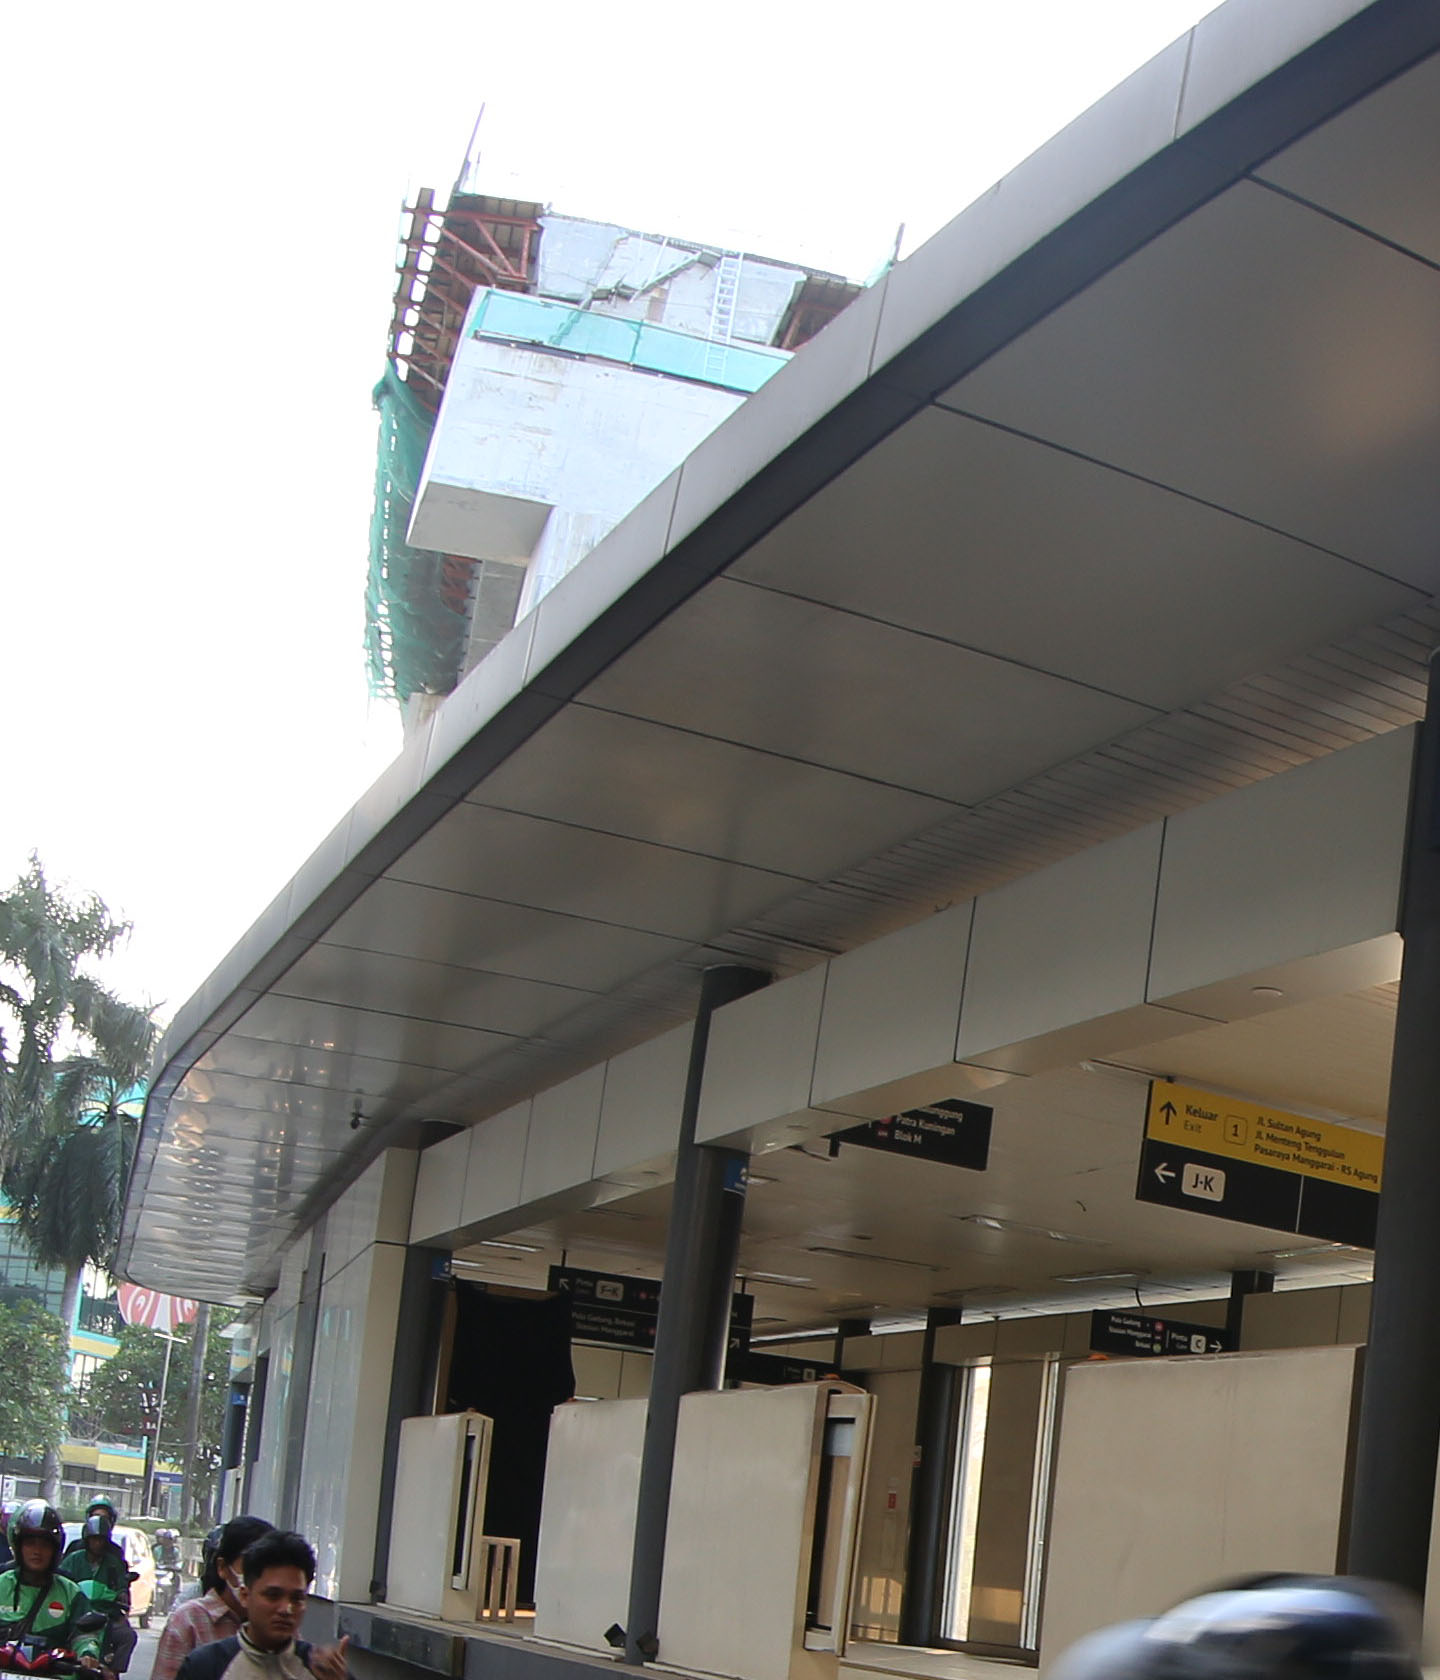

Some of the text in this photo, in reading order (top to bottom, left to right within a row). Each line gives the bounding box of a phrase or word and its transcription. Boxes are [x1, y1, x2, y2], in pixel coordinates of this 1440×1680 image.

[1185, 1104, 1218, 1122] Keluar
[1183, 1121, 1202, 1134] Exit
[1232, 1124, 1239, 1137] 1
[1267, 1118, 1294, 1133] Sultan
[1295, 1125, 1322, 1142] Agung
[1266, 1132, 1302, 1151] Menteng
[1292, 1152, 1335, 1171] Manggarai
[1341, 1164, 1352, 1176] RS
[1353, 1167, 1378, 1184] Agung
